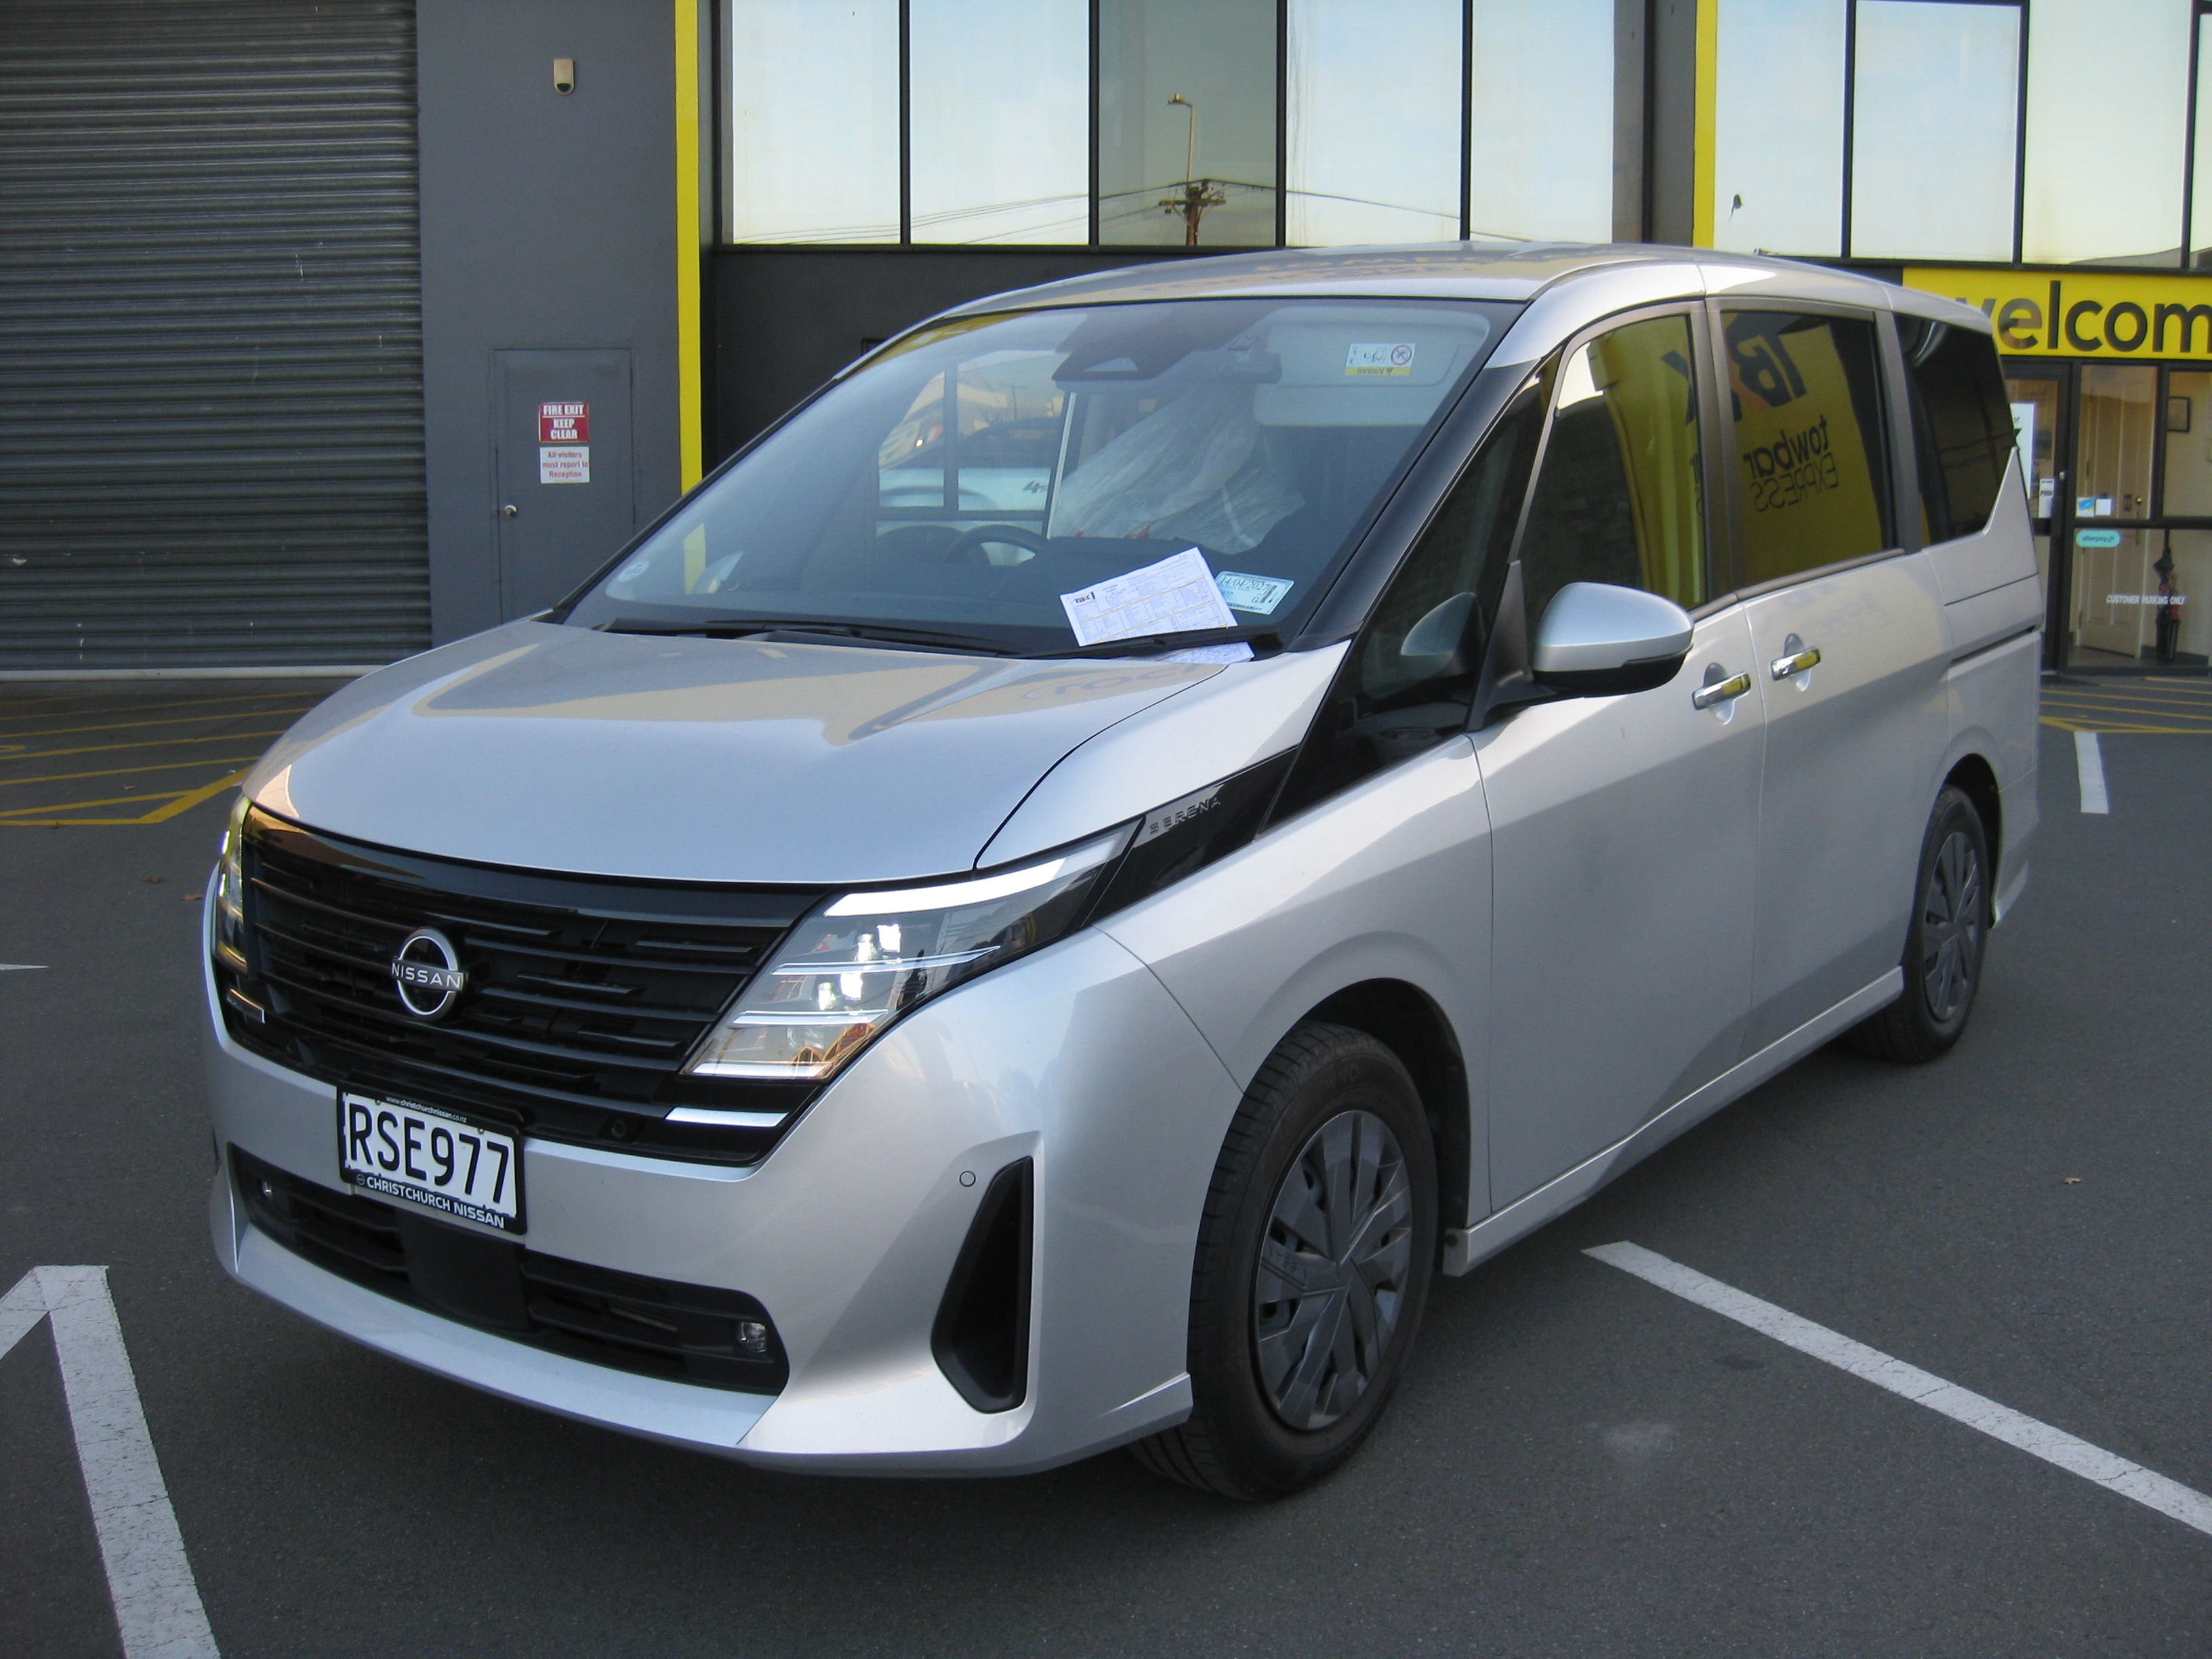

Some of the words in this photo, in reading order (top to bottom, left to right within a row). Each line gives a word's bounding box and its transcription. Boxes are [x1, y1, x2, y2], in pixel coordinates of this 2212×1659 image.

[1954, 280, 2212, 352] elcom
[543, 405, 563, 415] FIRE
[565, 405, 584, 415] EXIT
[553, 418, 575, 428] KEEP
[550, 429, 578, 440] CLEAR
[560, 462, 581, 470] report
[549, 470, 582, 478] Reception
[2106, 595, 2140, 605] CUSTOMER
[2141, 595, 2169, 605] PARKING
[2169, 595, 2186, 605] ONLY
[1149, 796, 1221, 835] SERENA
[392, 962, 460, 988] NISSAN
[349, 1103, 509, 1204] RSE977
[367, 1176, 451, 1212] CHRISTCHURCH
[453, 1202, 504, 1229] NISSAN
